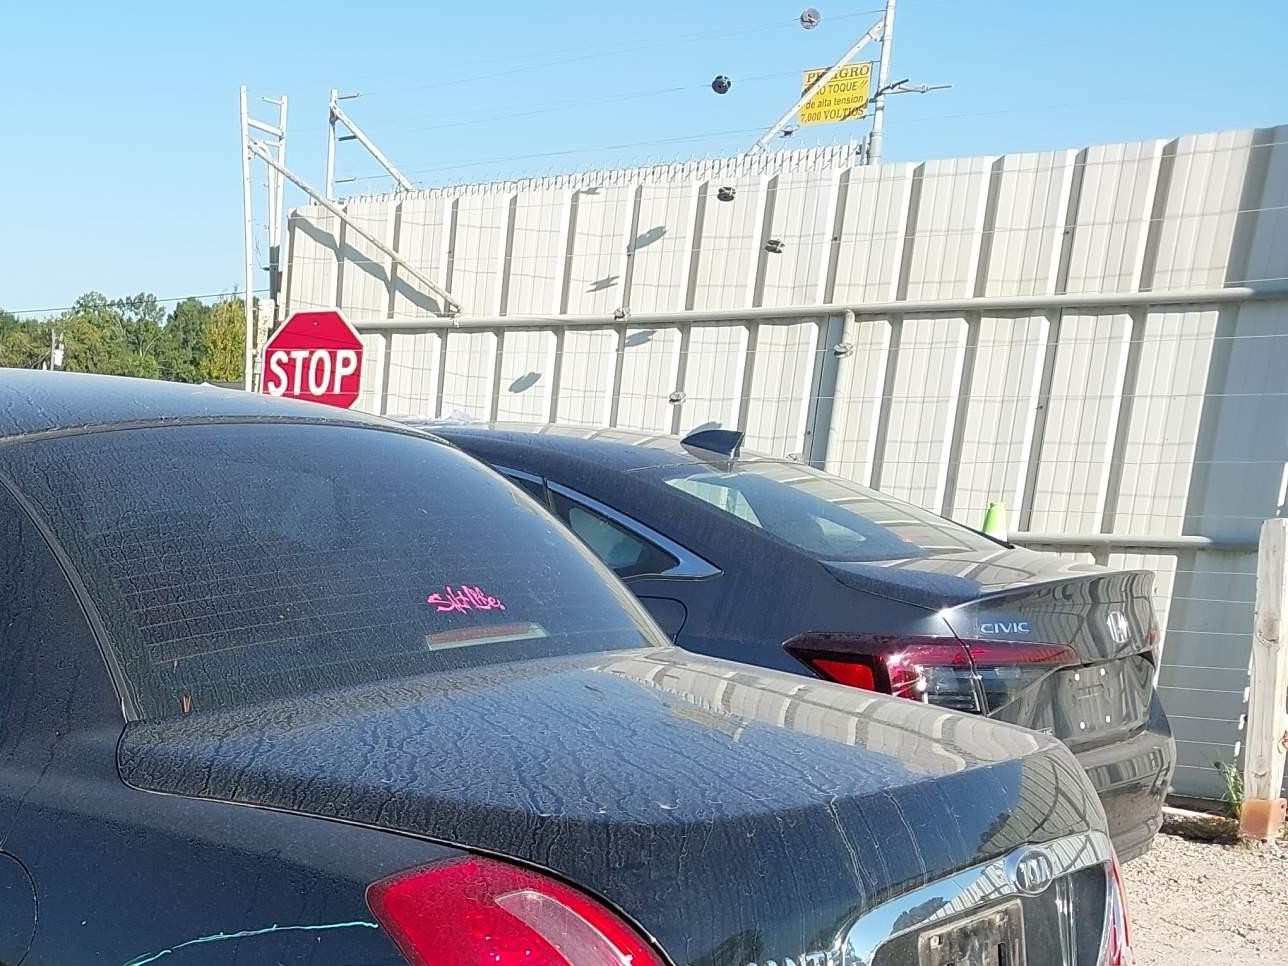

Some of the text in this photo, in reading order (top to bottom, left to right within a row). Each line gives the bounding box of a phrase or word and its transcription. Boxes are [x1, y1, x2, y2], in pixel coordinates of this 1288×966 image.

[817, 98, 832, 108] alta
[834, 95, 864, 106] tension
[824, 106, 864, 120] VOLTIOS
[267, 349, 358, 397] STOP
[980, 622, 1031, 634] CIVIC
